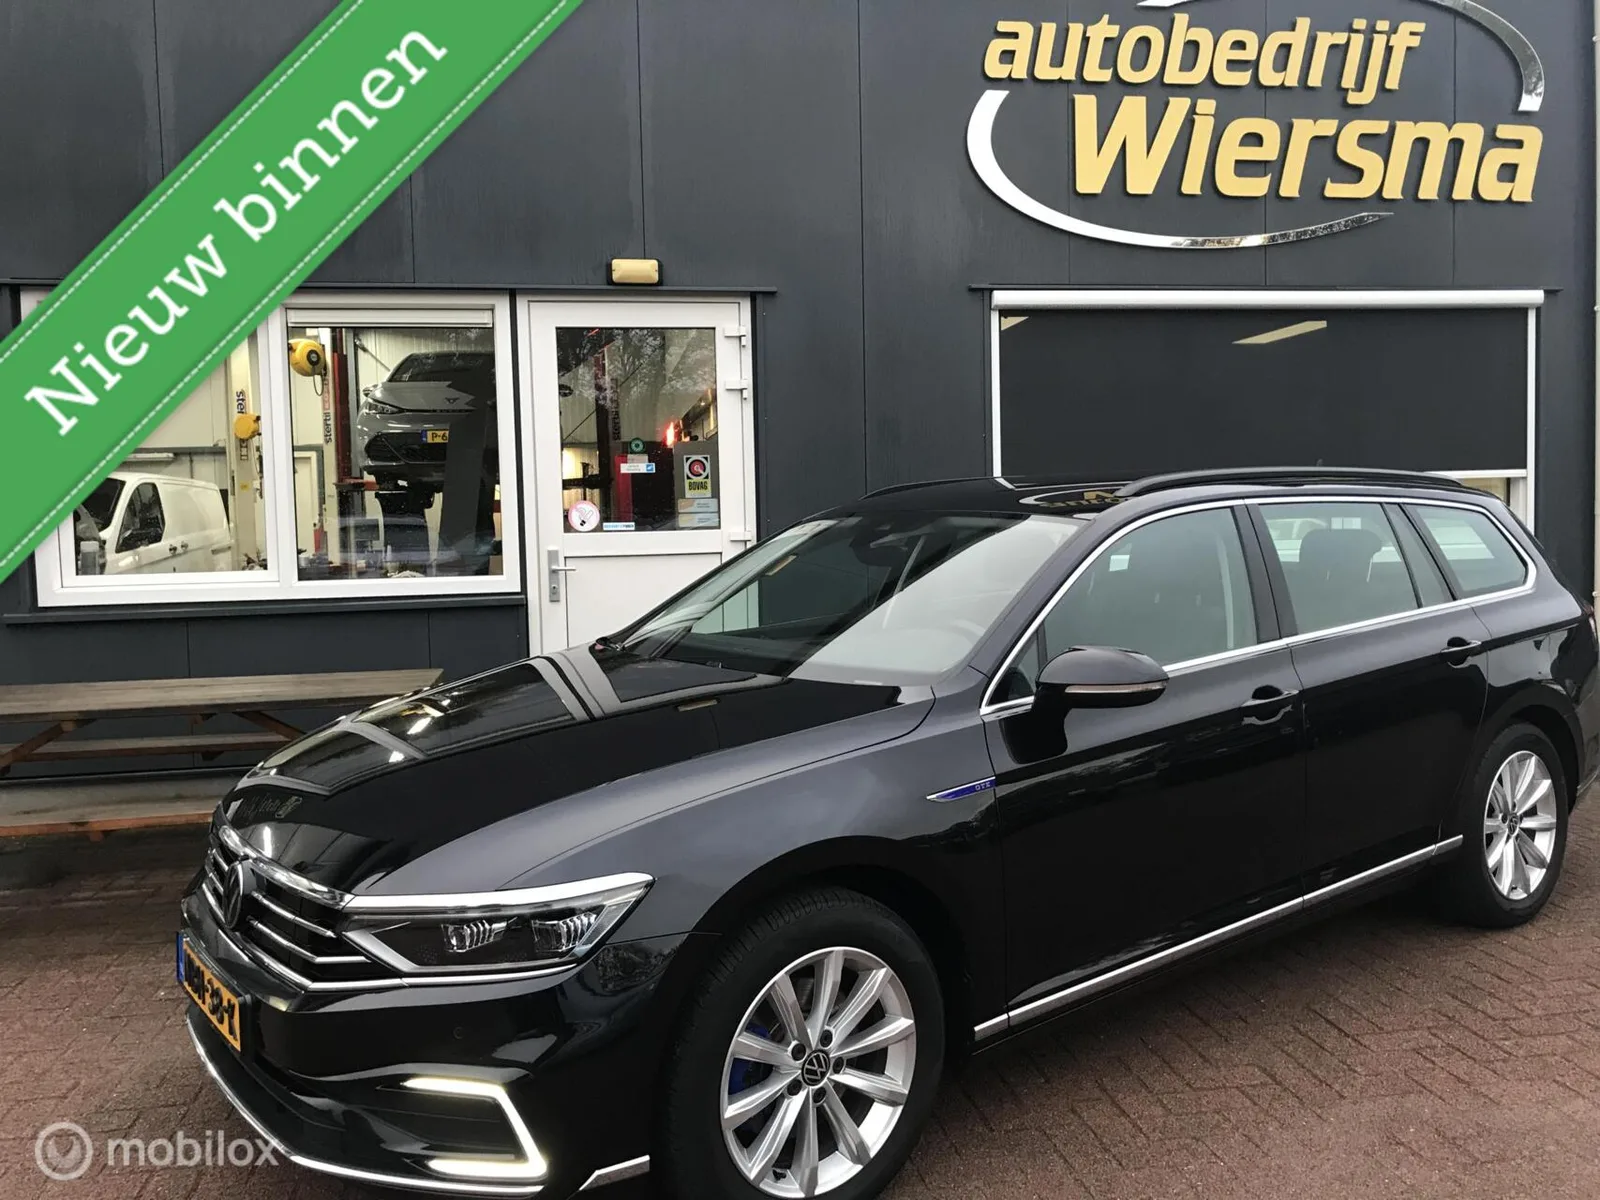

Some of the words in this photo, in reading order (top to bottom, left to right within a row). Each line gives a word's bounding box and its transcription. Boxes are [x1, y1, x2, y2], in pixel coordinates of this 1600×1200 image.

[983, 13, 1427, 105] autobedrijf
[1073, 94, 1543, 202] Wiersma
[687, 481, 709, 491] BOVAG
